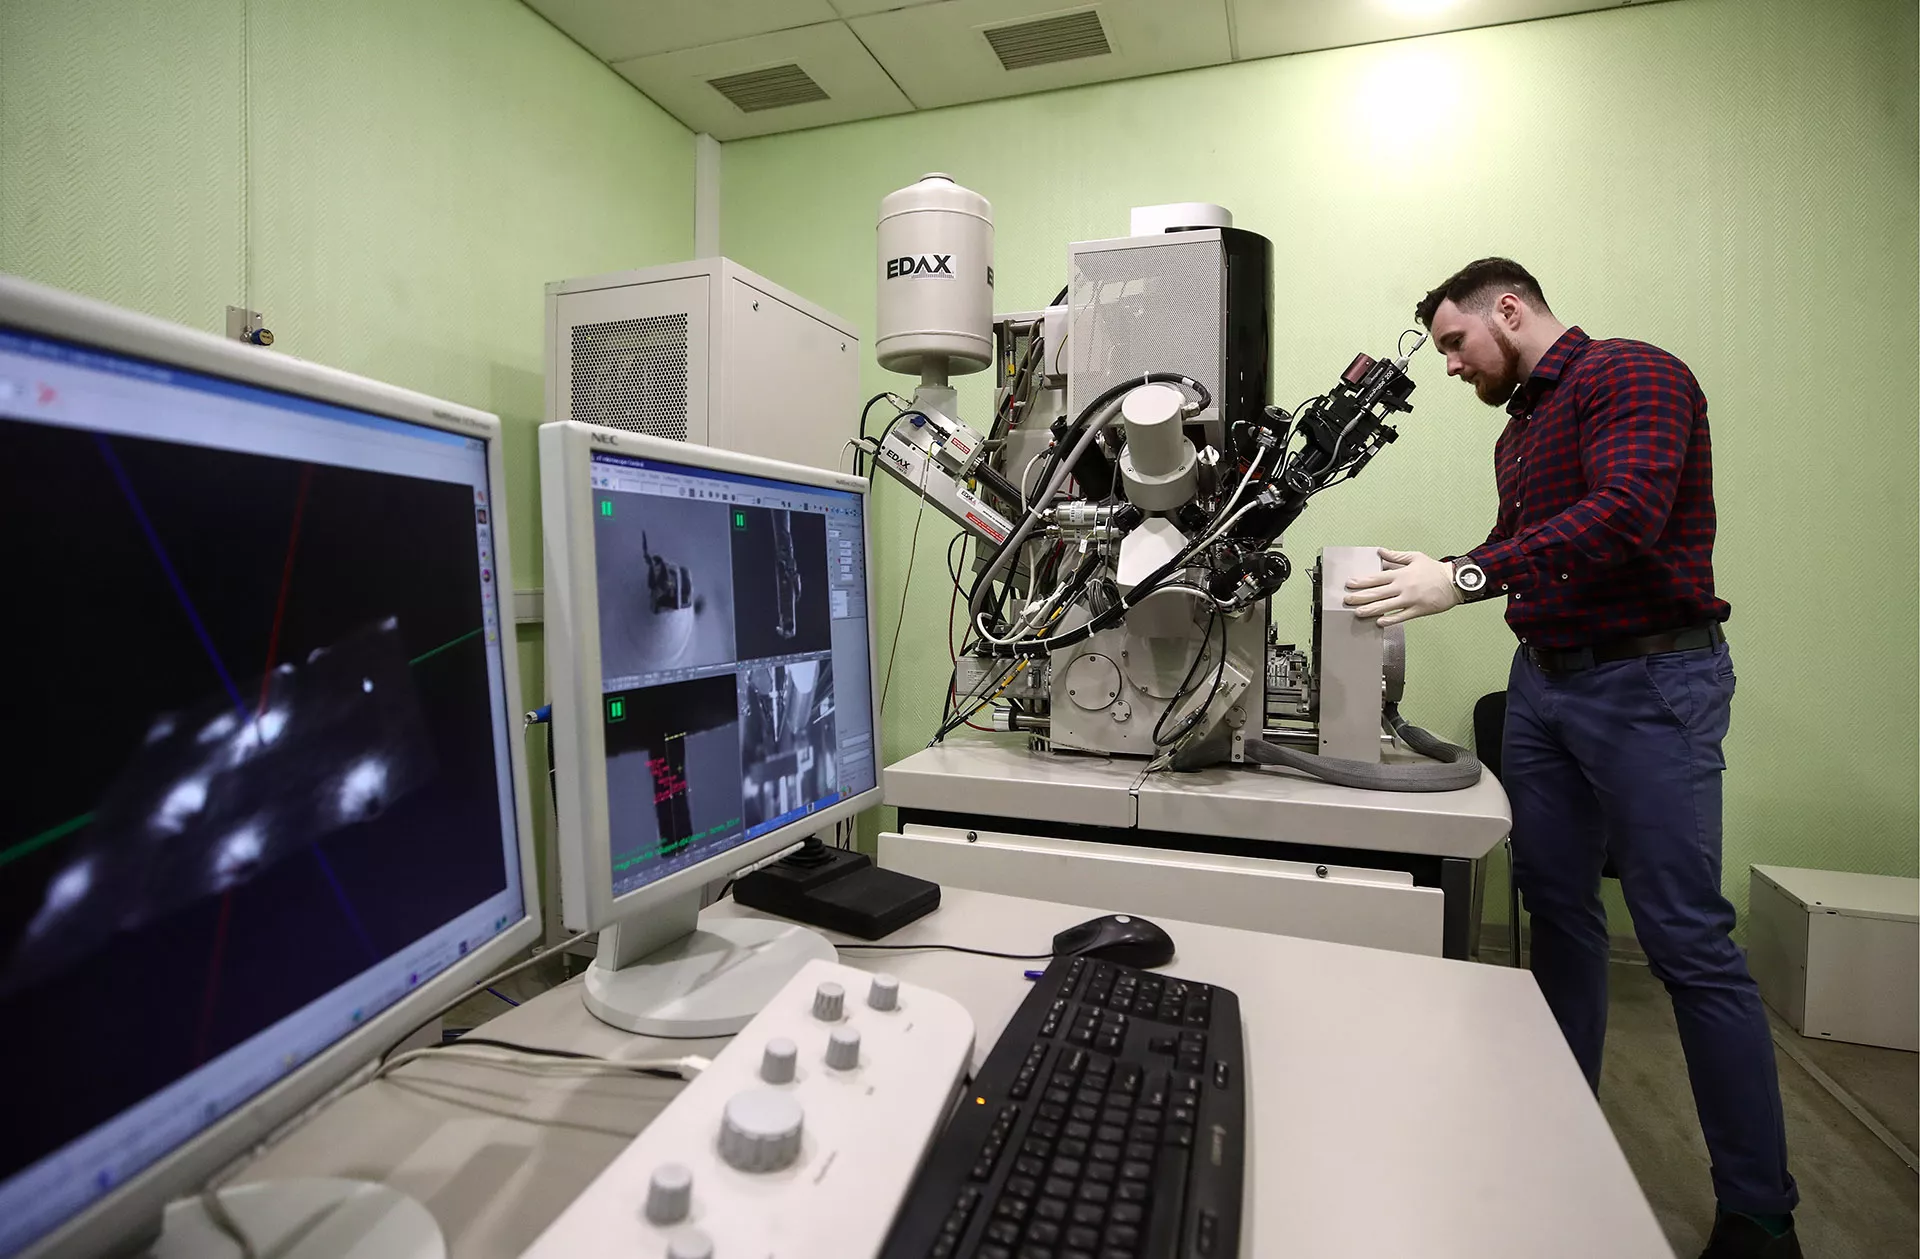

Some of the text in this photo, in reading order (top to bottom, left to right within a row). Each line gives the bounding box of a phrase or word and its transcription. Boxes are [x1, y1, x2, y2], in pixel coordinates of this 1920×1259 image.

[886, 254, 952, 280] EDAX
[1384, 370, 1394, 380] 200
[591, 432, 619, 446] NEC
[886, 449, 911, 469] EDAX
